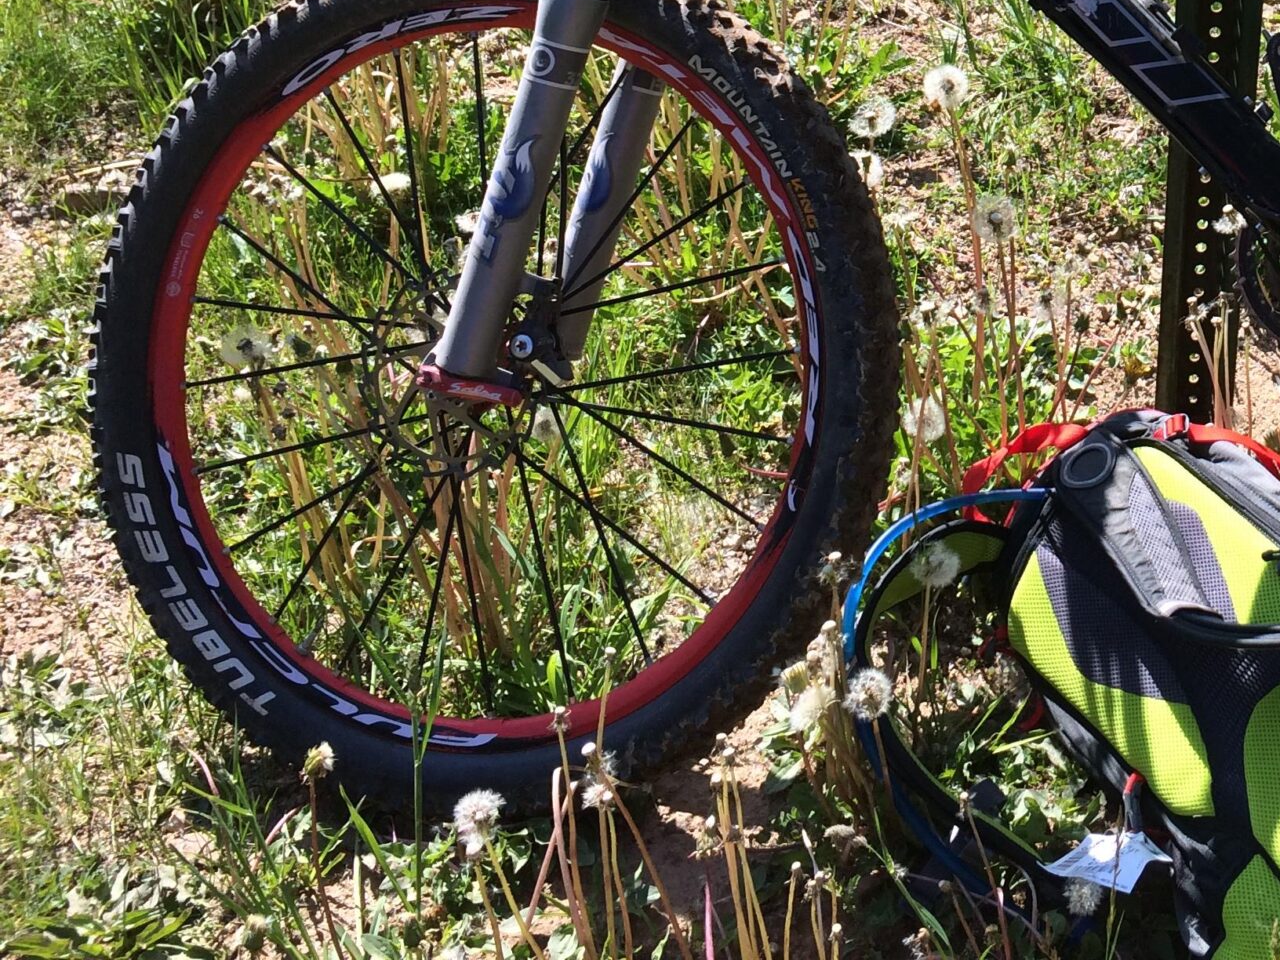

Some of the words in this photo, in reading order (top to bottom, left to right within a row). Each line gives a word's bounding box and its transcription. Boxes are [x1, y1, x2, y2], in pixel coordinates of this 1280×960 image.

[281, 5, 526, 96] ZERO
[597, 26, 792, 220] META
[688, 54, 792, 179] MOUNTAIN
[805, 231, 828, 273] 2.4
[449, 380, 503, 401] Salsa
[116, 452, 277, 716] TUBELESS
[157, 442, 498, 747] FULCRUM
